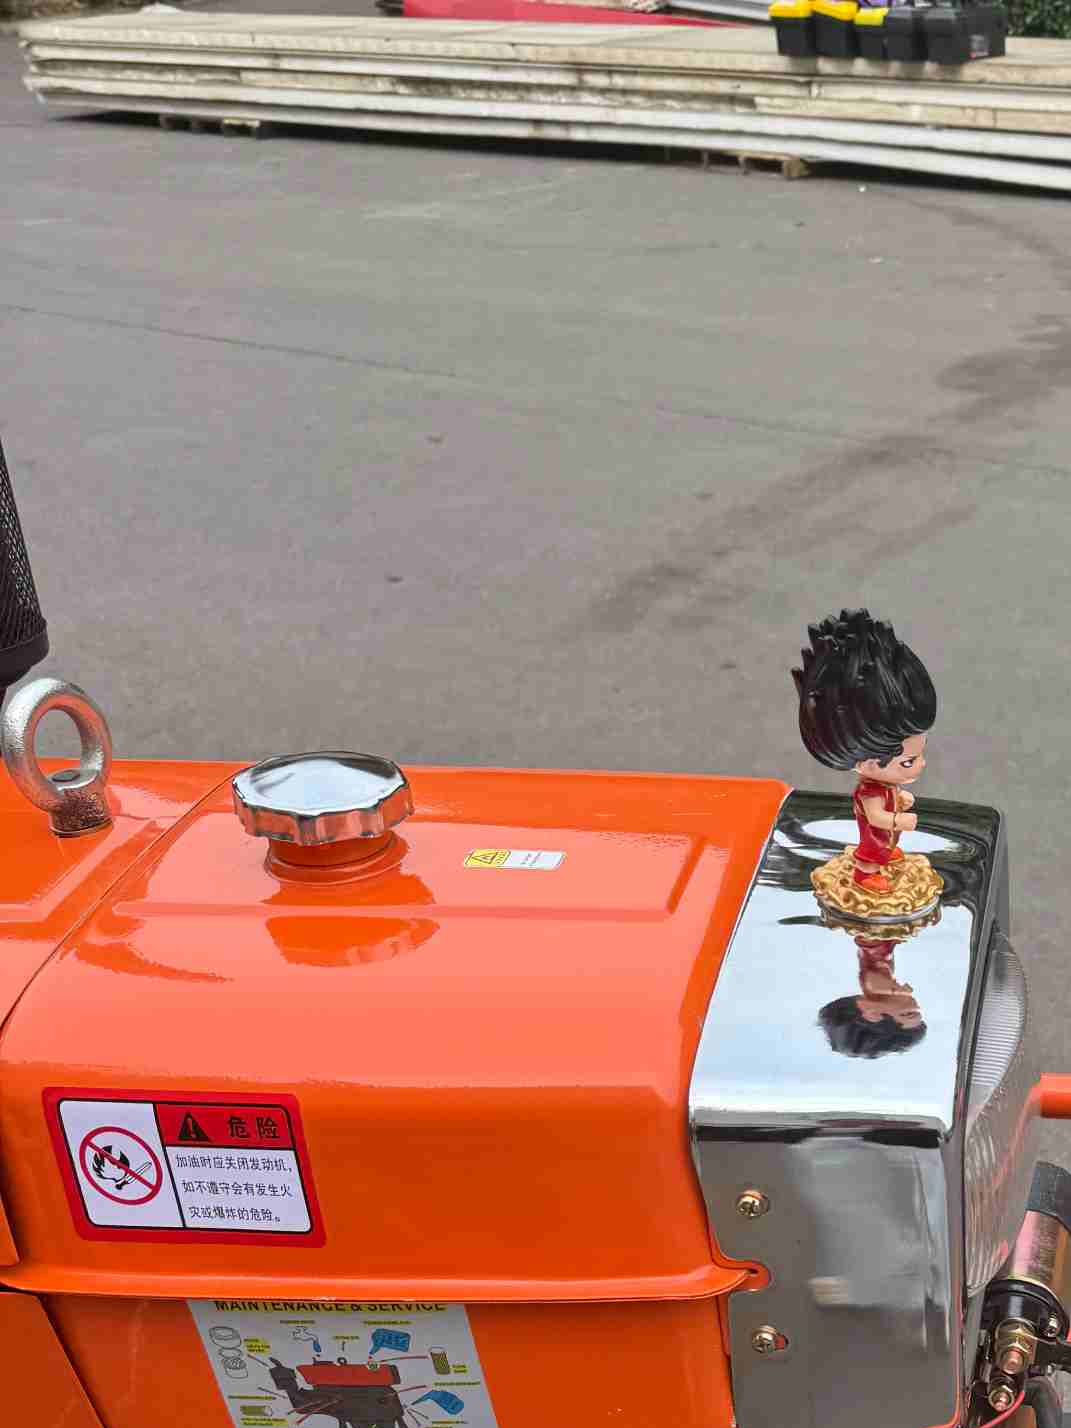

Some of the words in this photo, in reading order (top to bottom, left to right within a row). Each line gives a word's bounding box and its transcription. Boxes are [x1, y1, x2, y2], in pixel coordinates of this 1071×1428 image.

[228, 1115, 280, 1139] 危险
[214, 1301, 346, 1312] MAINTENANCE
[367, 1303, 447, 1312] SERVICE
